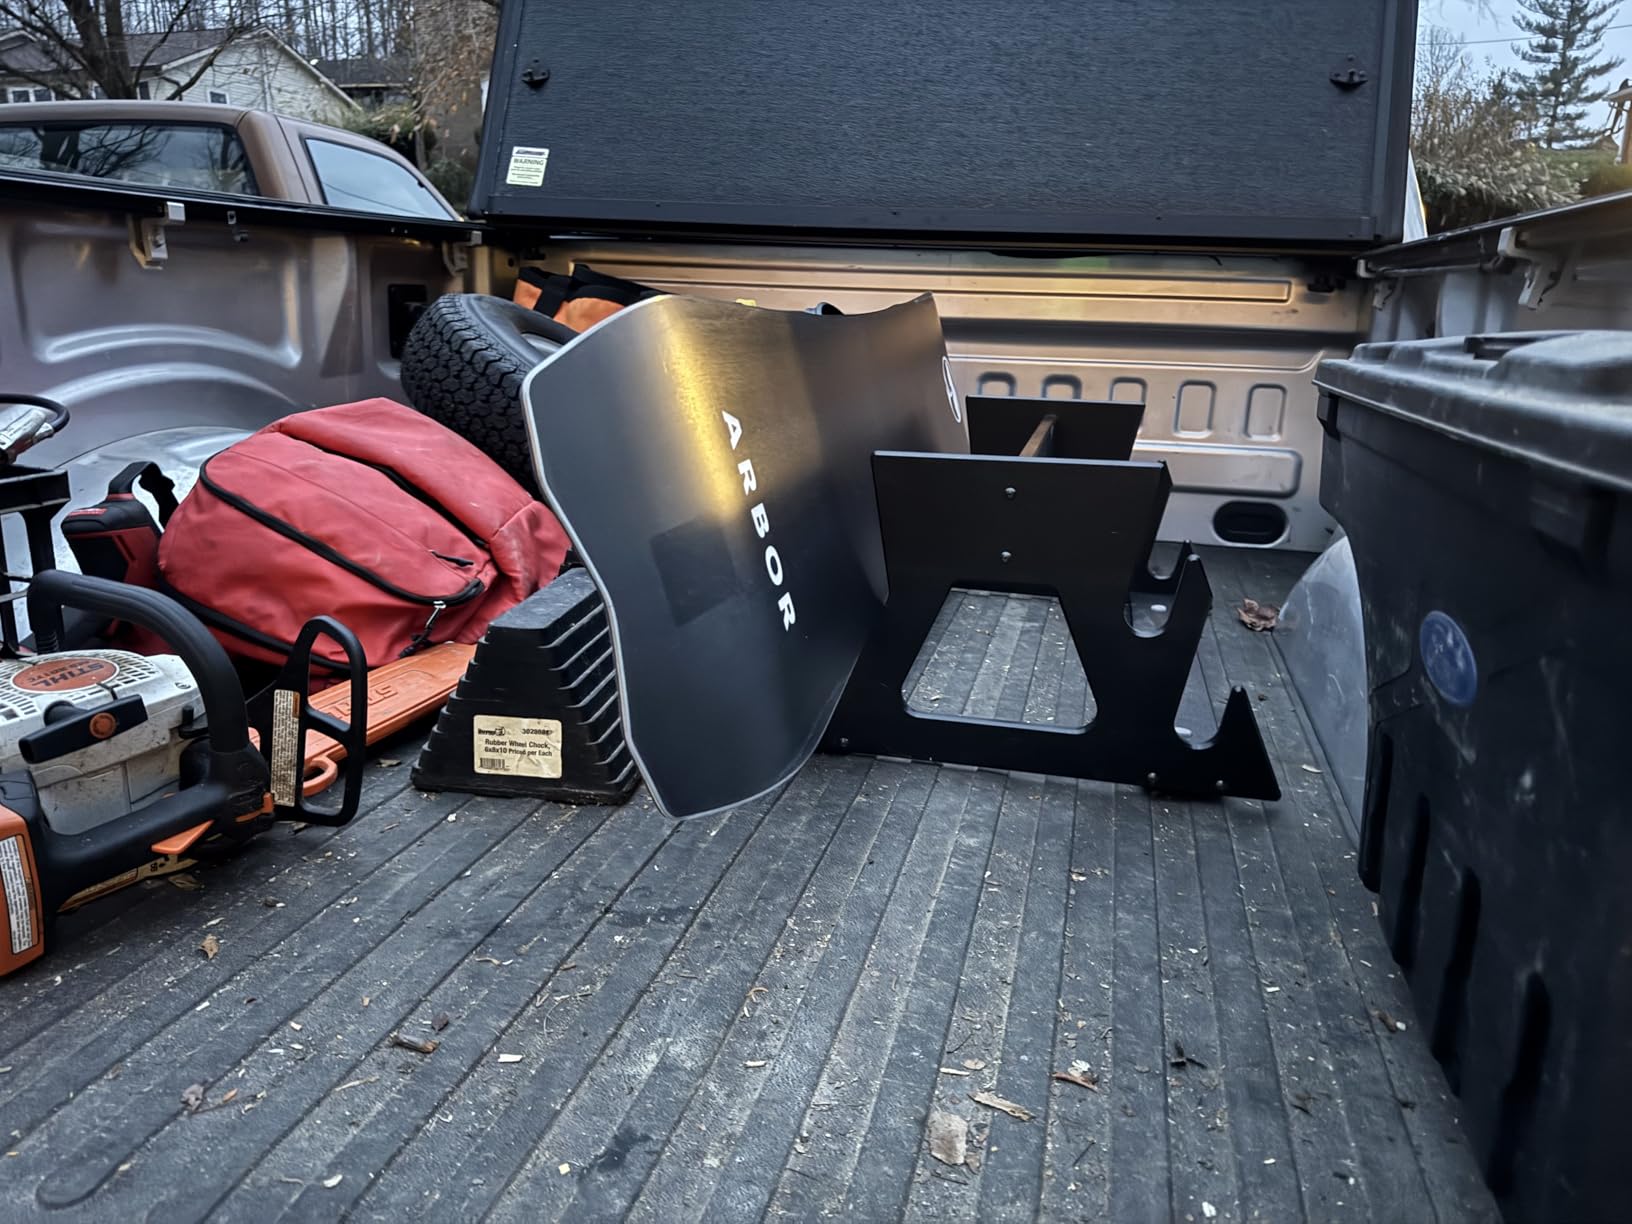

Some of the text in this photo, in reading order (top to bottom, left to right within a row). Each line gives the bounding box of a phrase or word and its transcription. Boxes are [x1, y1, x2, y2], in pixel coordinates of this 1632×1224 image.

[722, 410, 796, 631] ARBOR
[32, 663, 104, 686] STIHL
[484, 746, 507, 754] 6x8x10
[508, 740, 527, 748] Wheel
[528, 741, 551, 750] Chock,
